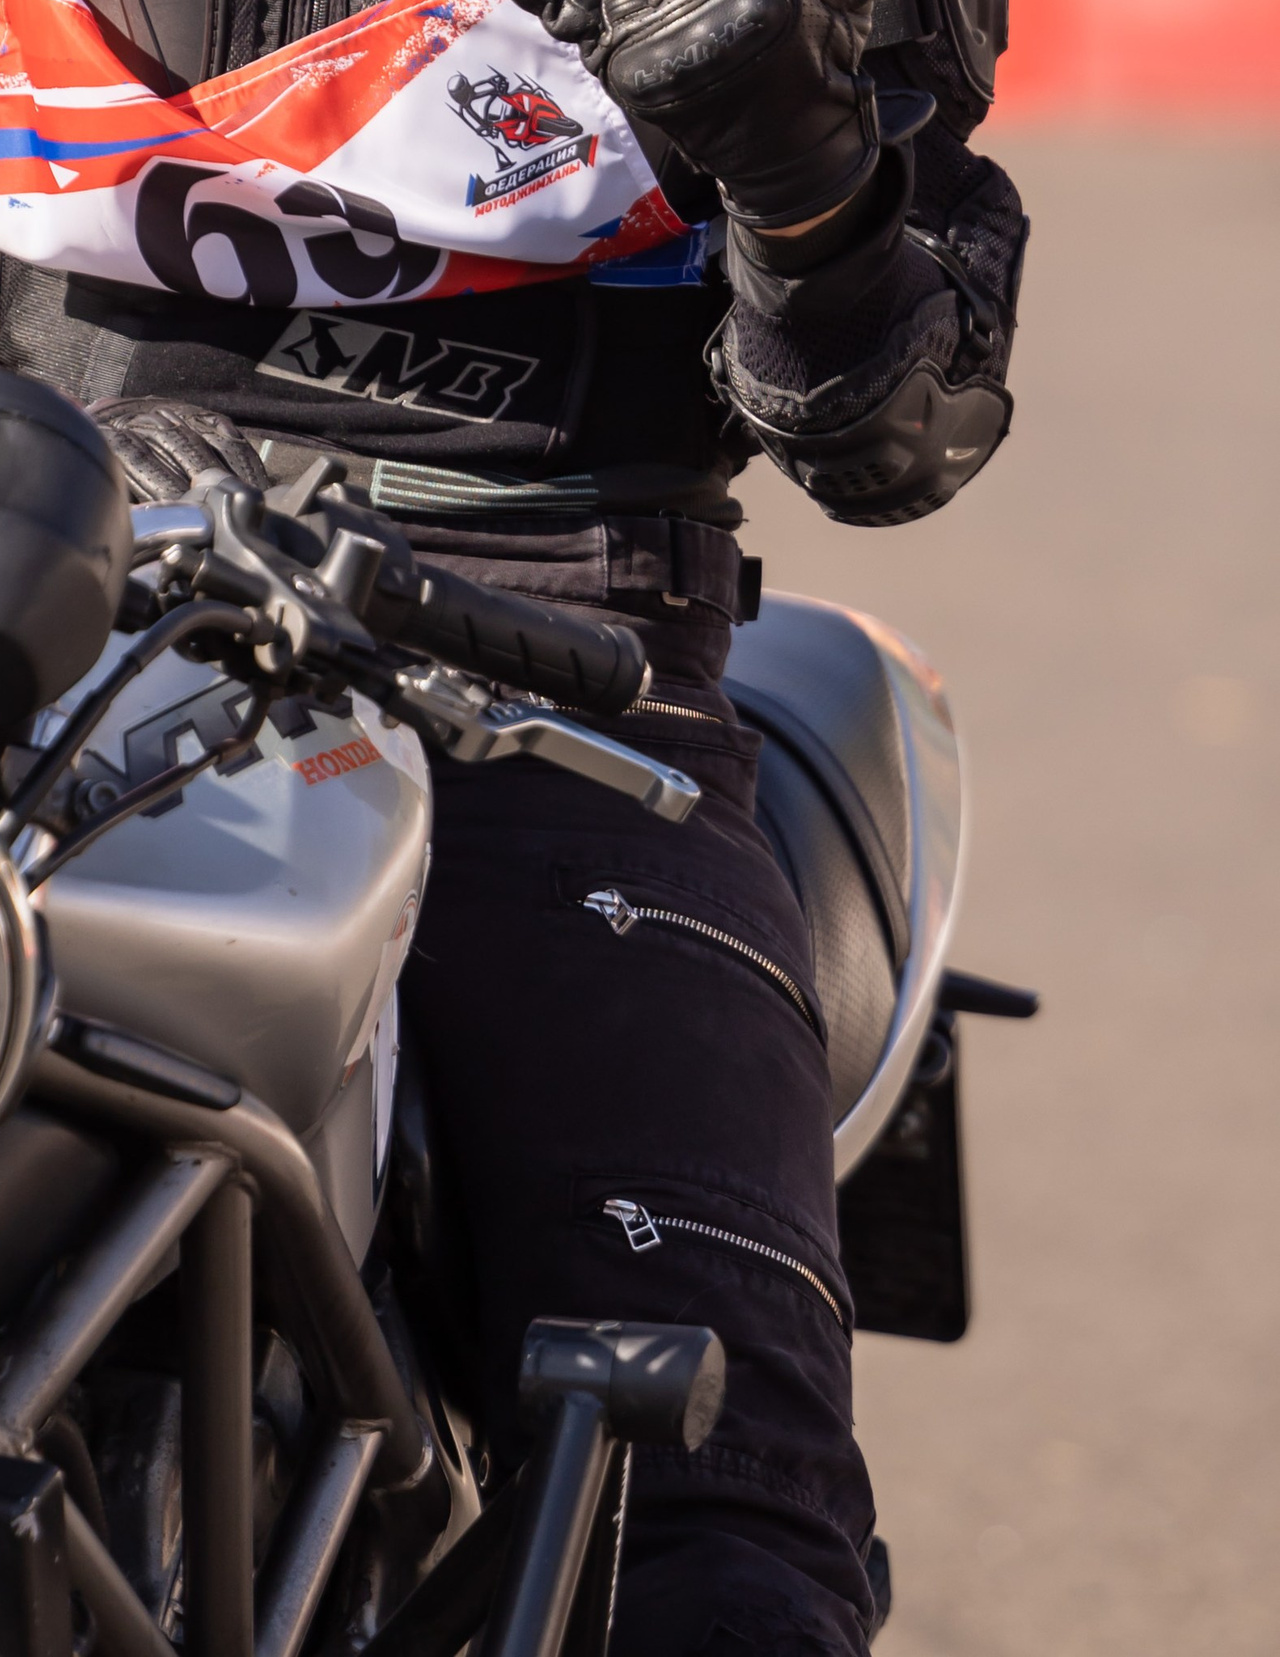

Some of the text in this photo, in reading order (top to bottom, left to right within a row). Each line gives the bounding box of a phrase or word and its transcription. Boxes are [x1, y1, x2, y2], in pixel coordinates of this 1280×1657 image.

[474, 160, 581, 218] МОТОДЖИМХАНЫ
[484, 143, 577, 196] ФЕДЕРАЦИЯ
[292, 737, 383, 787] HONDA
